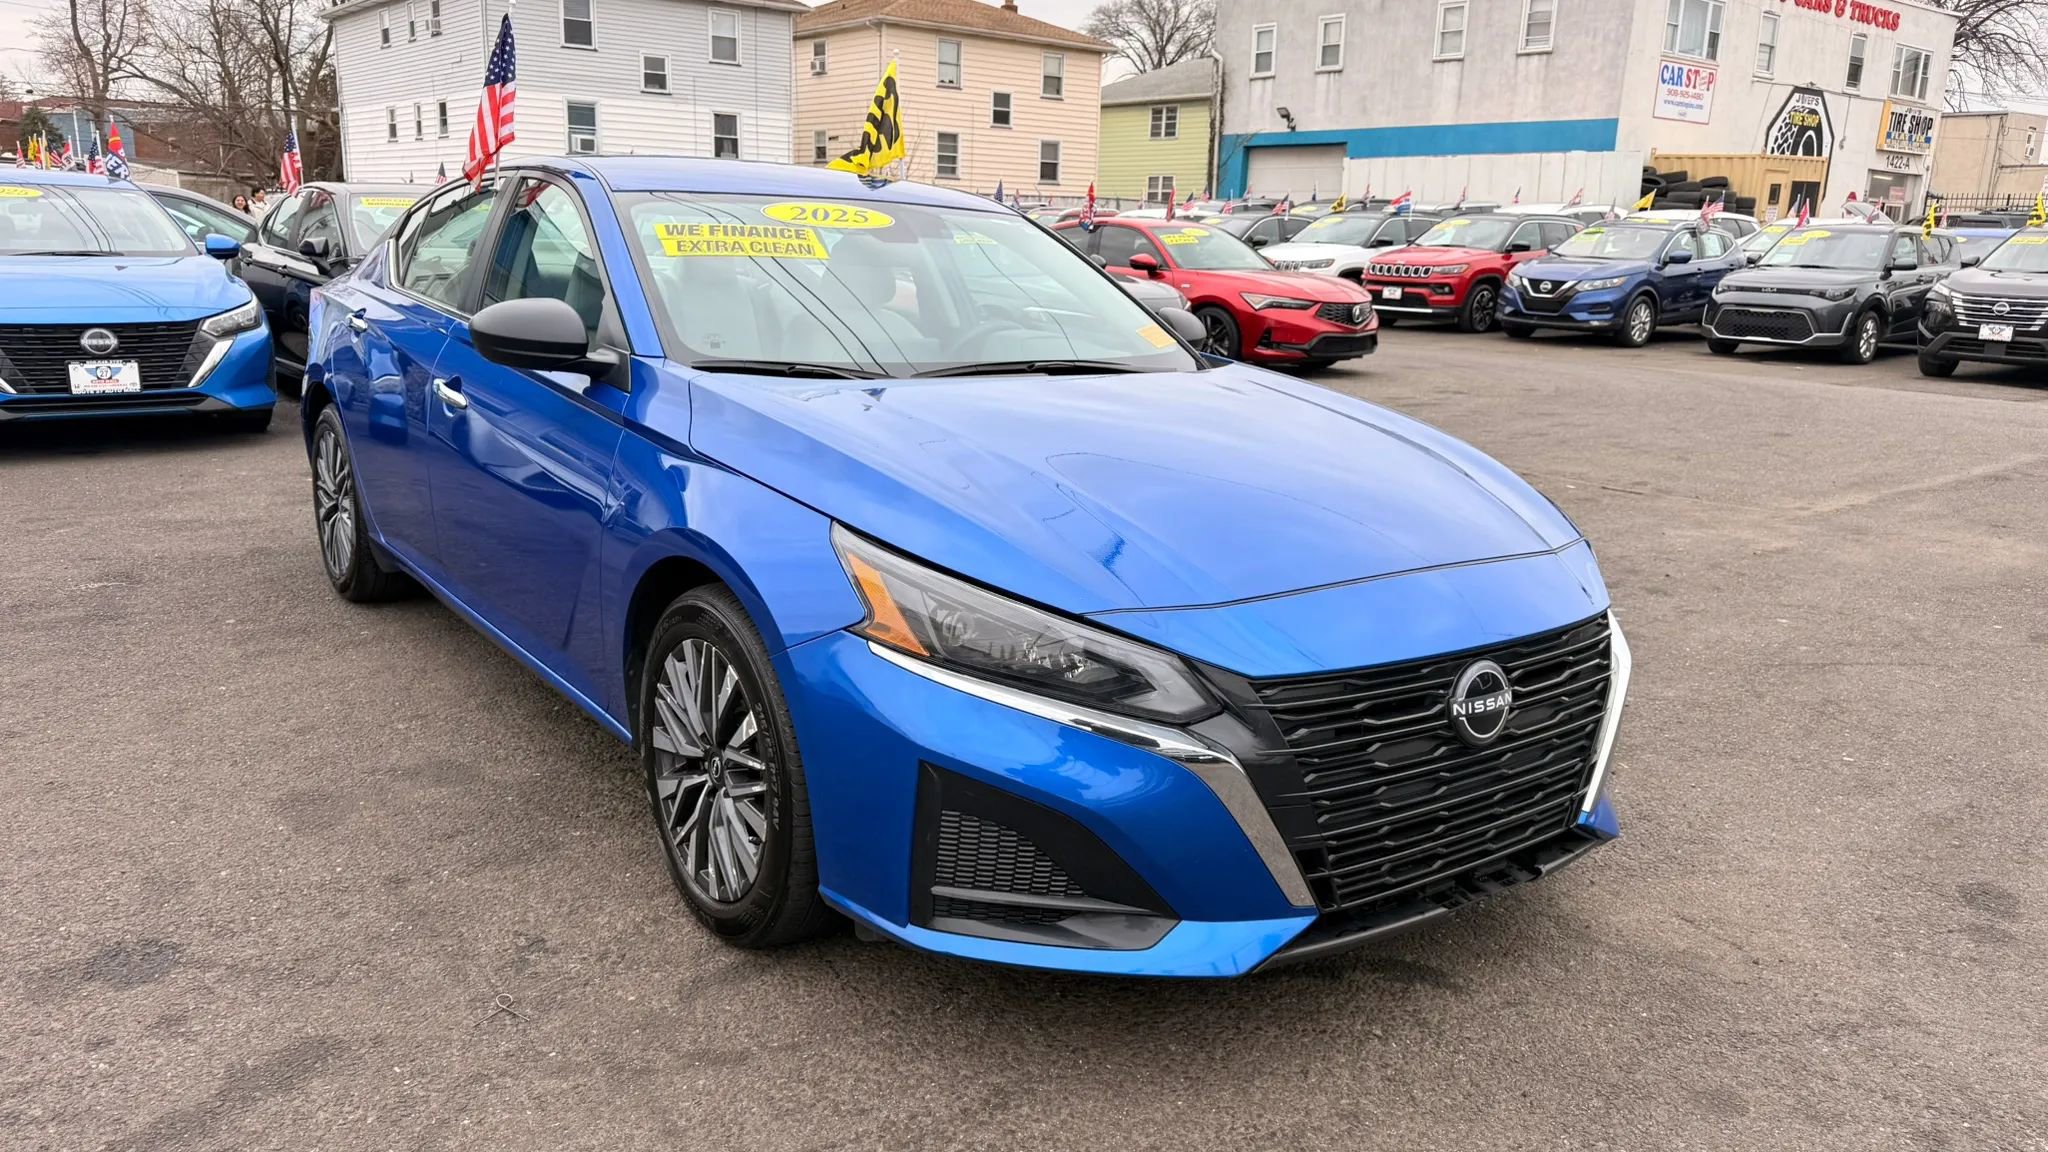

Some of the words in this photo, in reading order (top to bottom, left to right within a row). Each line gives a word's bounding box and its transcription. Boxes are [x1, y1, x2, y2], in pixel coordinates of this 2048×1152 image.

[1834, 0, 1846, 17] &
[1850, 1, 1900, 31] TRUCKS
[1661, 64, 1684, 87] CAR
[1889, 112, 1908, 132] TIRE
[1908, 115, 1933, 136] SHOP
[1886, 155, 1910, 170] 1422-A
[790, 206, 869, 224] 2025
[663, 224, 702, 236] WE
[709, 225, 807, 240] FINANCE
[676, 239, 747, 253] EXTRA
[750, 241, 815, 255] CLEAN
[99, 370, 109, 378] 27
[1453, 690, 1512, 716] NISSAN
